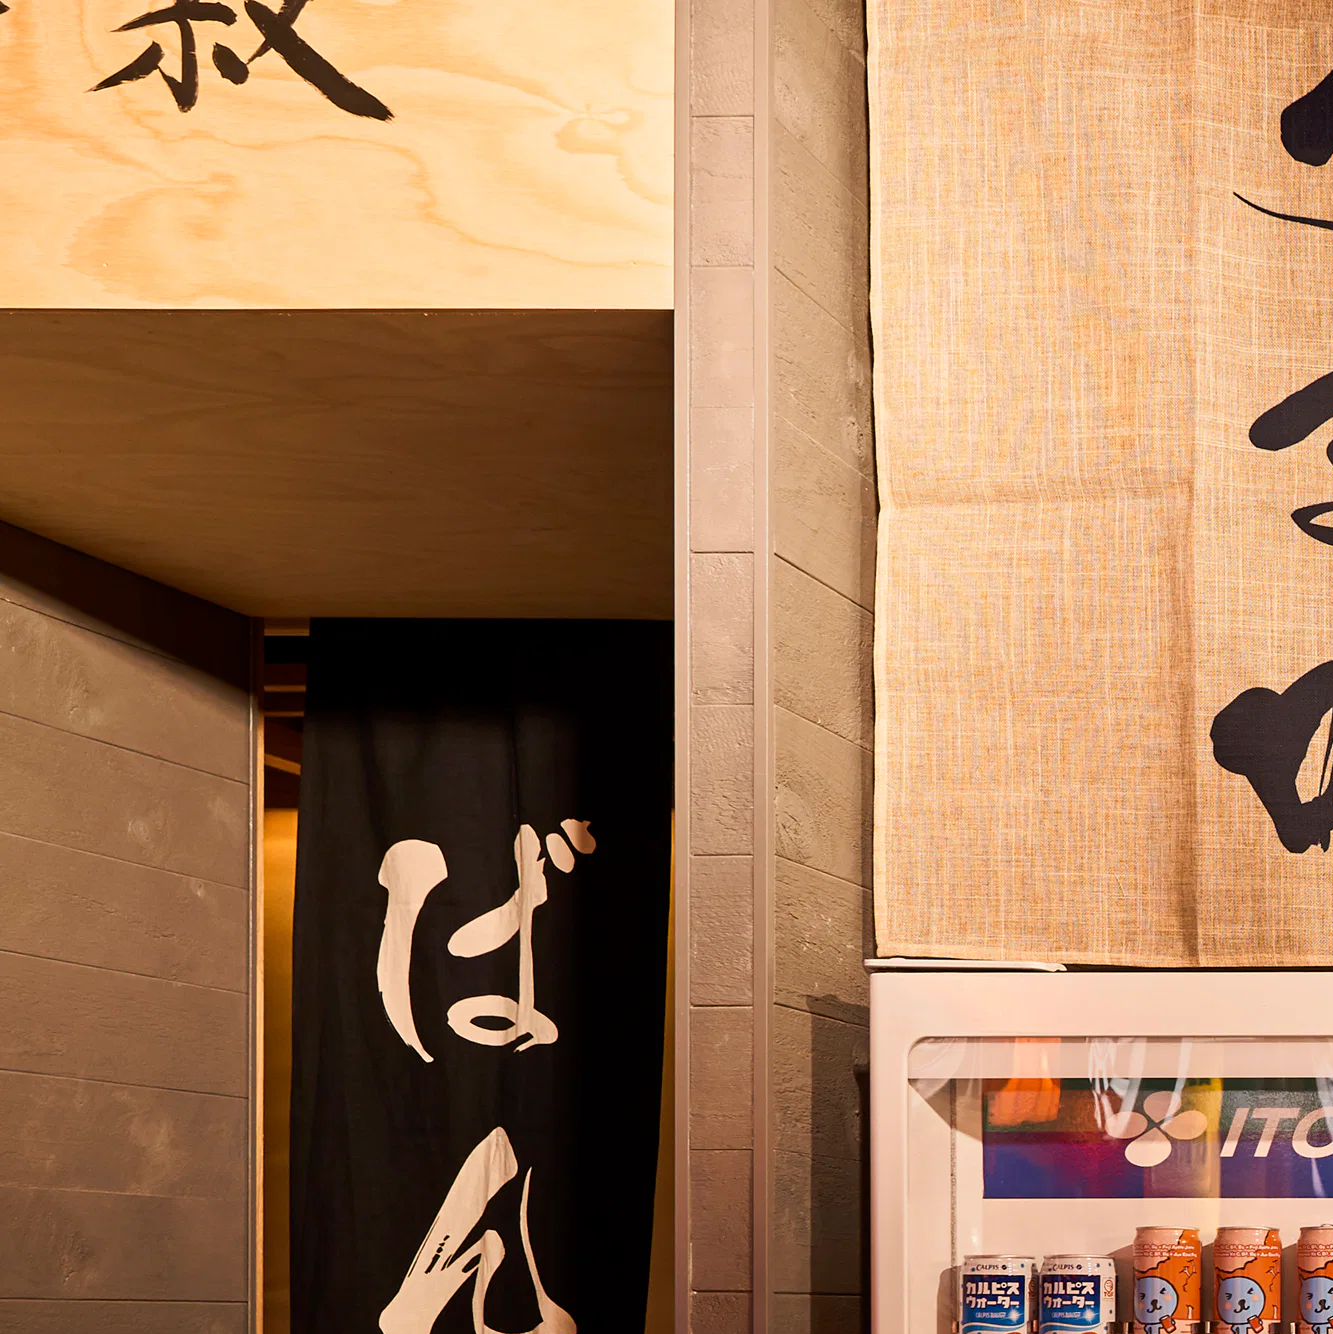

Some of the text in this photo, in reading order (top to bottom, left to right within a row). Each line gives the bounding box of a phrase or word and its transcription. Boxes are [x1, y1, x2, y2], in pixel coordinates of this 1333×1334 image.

[966, 1282, 1020, 1295] カルピス
[1043, 1282, 1095, 1295] カルピス
[966, 1296, 1020, 1309] ウォーター
[1043, 1296, 1095, 1309] ウォーター
